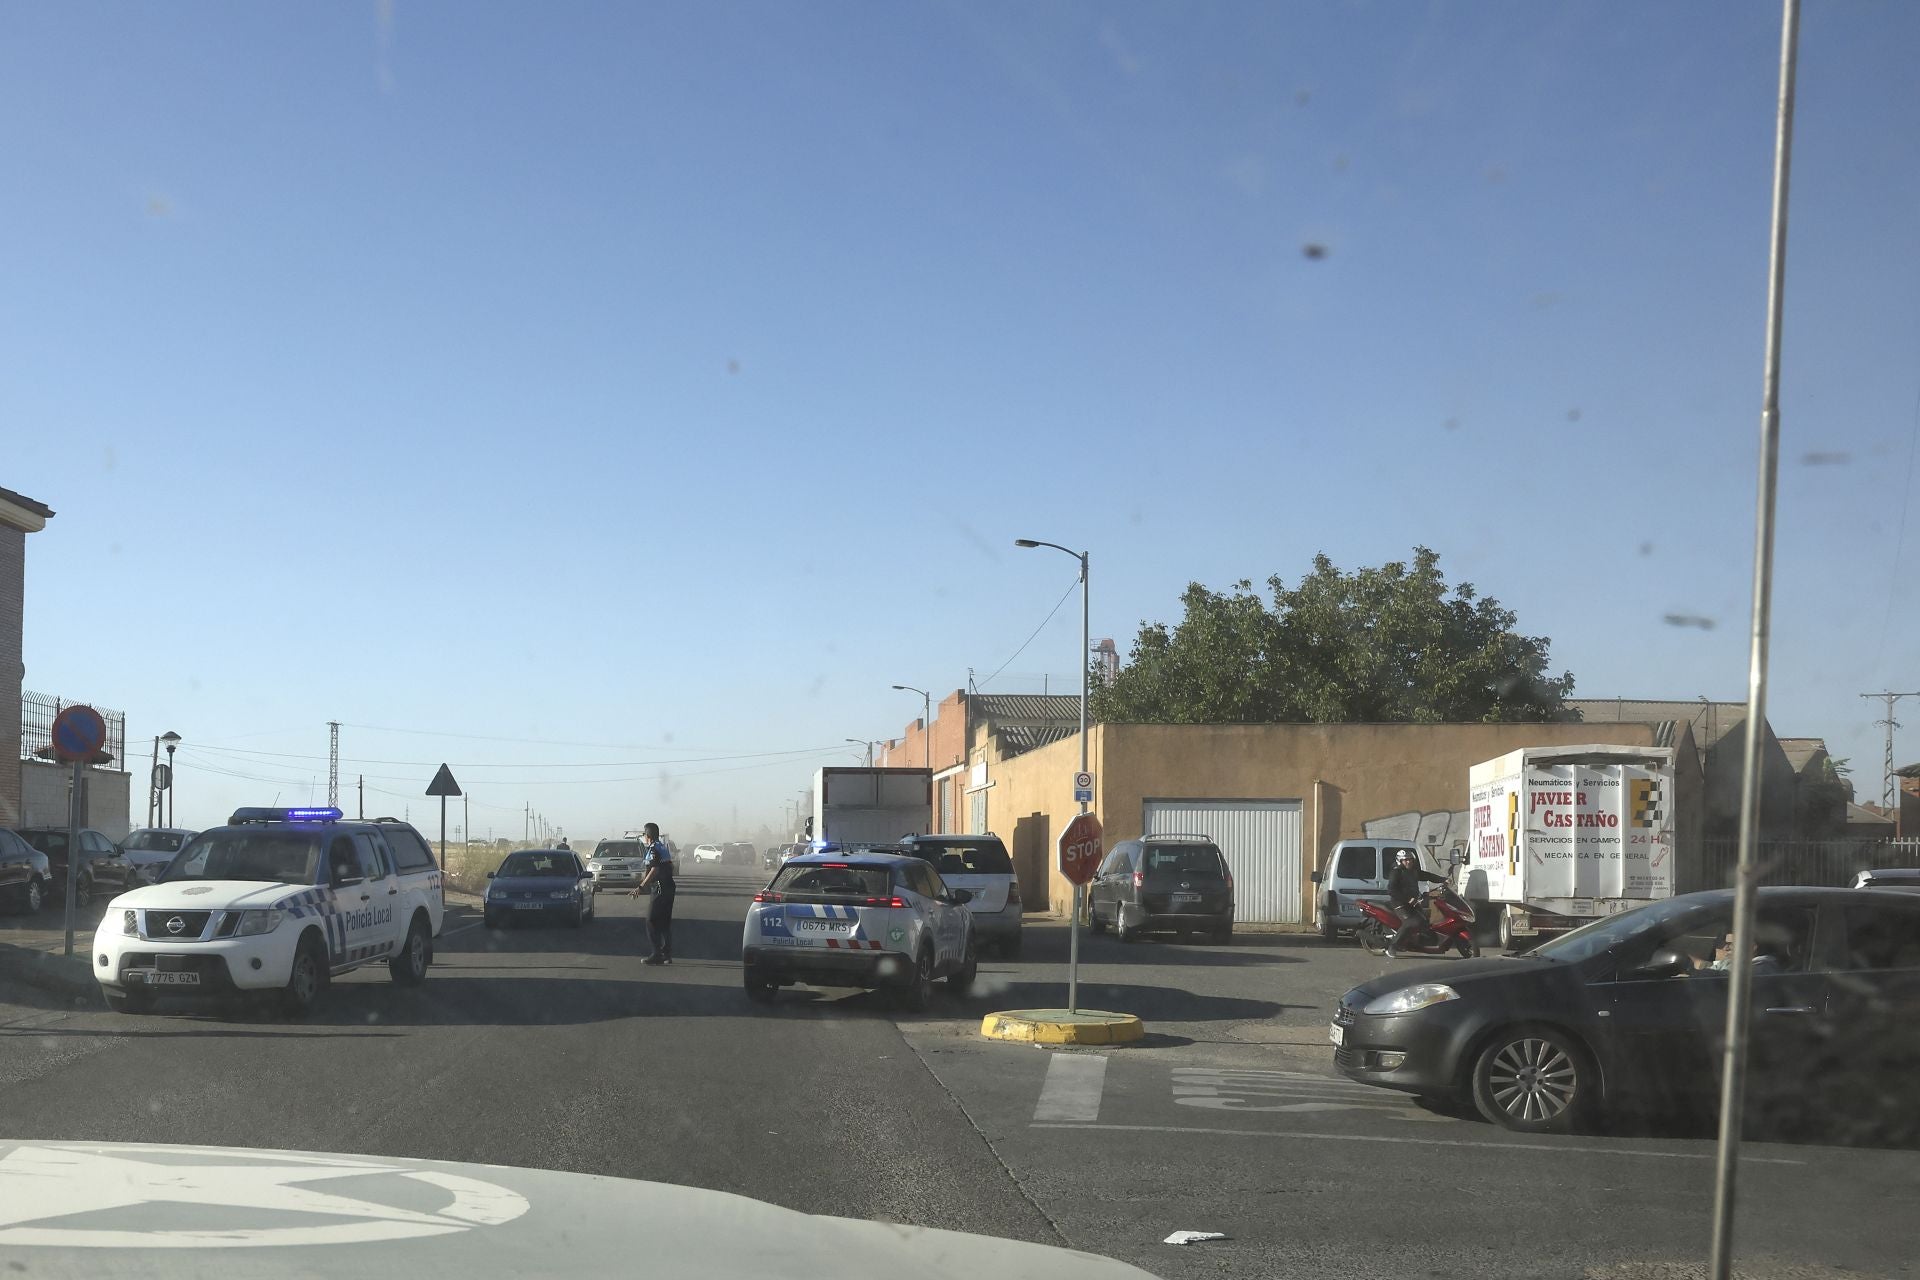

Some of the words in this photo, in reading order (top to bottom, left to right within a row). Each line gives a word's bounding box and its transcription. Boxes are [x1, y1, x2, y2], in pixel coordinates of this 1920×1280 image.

[1528, 778, 1572, 786] Neumáticos
[1576, 780, 1580, 788] y
[1583, 778, 1620, 787] Servicios
[1530, 791, 1587, 814] JAVIER
[1529, 836, 1573, 844] SERVICIOS
[1576, 836, 1588, 844] EN
[1590, 836, 1620, 844] CAMPO
[1630, 835, 1647, 844] 24
[1066, 838, 1100, 862] STOP
[1544, 852, 1589, 860] MECANCA
[1593, 852, 1605, 860] EN
[345, 907, 372, 931] Policía
[373, 904, 392, 926] Local
[763, 917, 783, 927] 112
[802, 921, 826, 932] 0676
[828, 922, 847, 932] MRS
